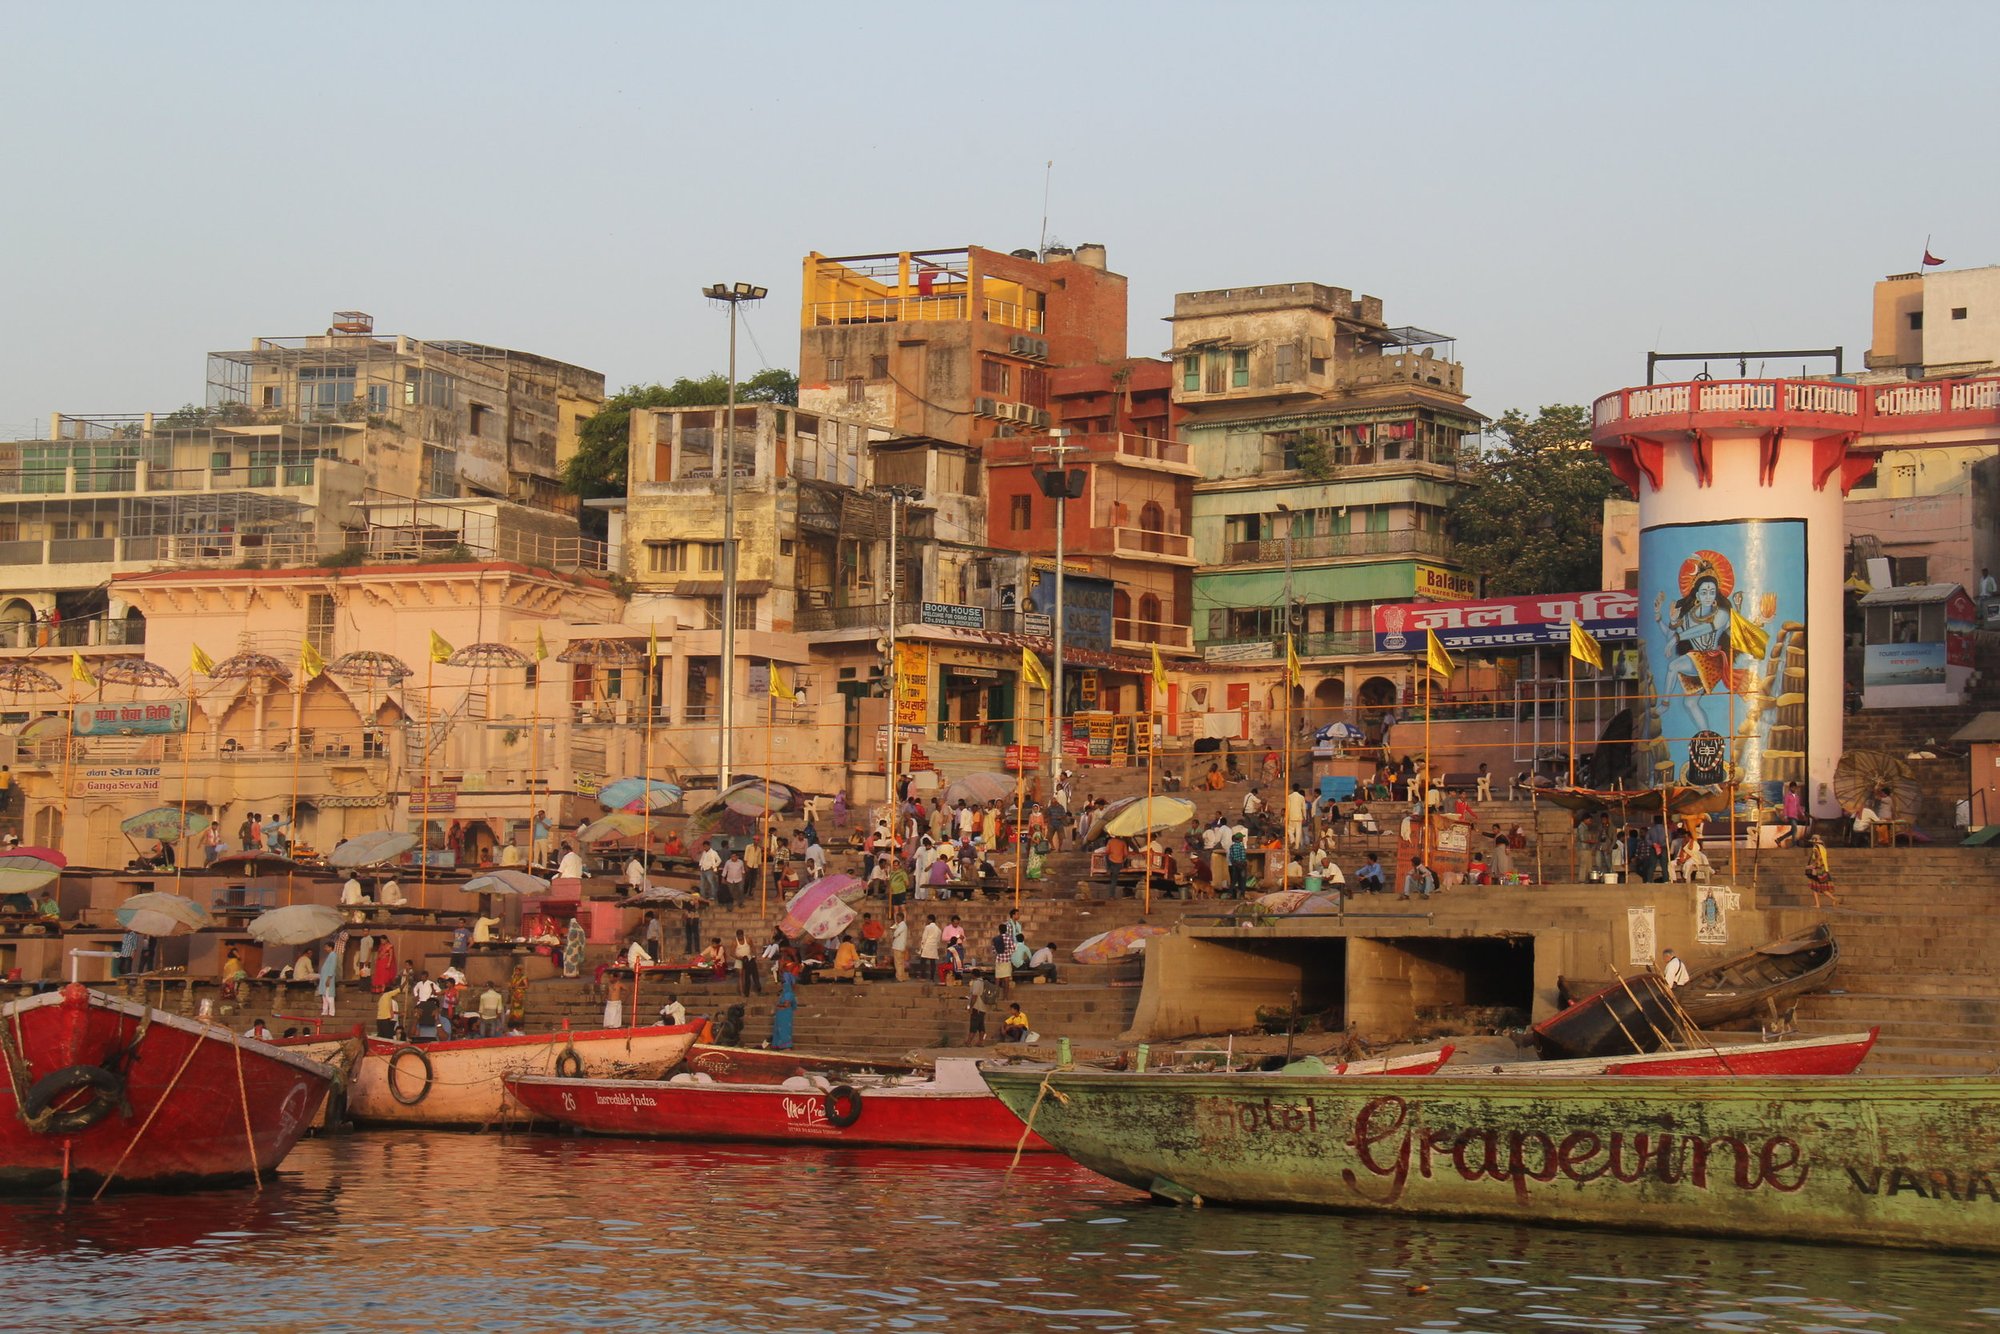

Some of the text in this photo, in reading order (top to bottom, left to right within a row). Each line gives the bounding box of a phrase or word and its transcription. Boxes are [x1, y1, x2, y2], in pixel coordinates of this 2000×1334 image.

[1427, 569, 1474, 593] Balajee
[924, 603, 981, 616] BOOK HOUSE
[1411, 605, 1519, 630] जल
[95, 703, 171, 721] गंगा सेवा निधि
[87, 781, 117, 791] Ganga
[118, 780, 141, 790] Seva
[561, 1092, 576, 1111] 26
[595, 1091, 632, 1106] Incredible
[1211, 1094, 1810, 1207] Hotel Grapevine
